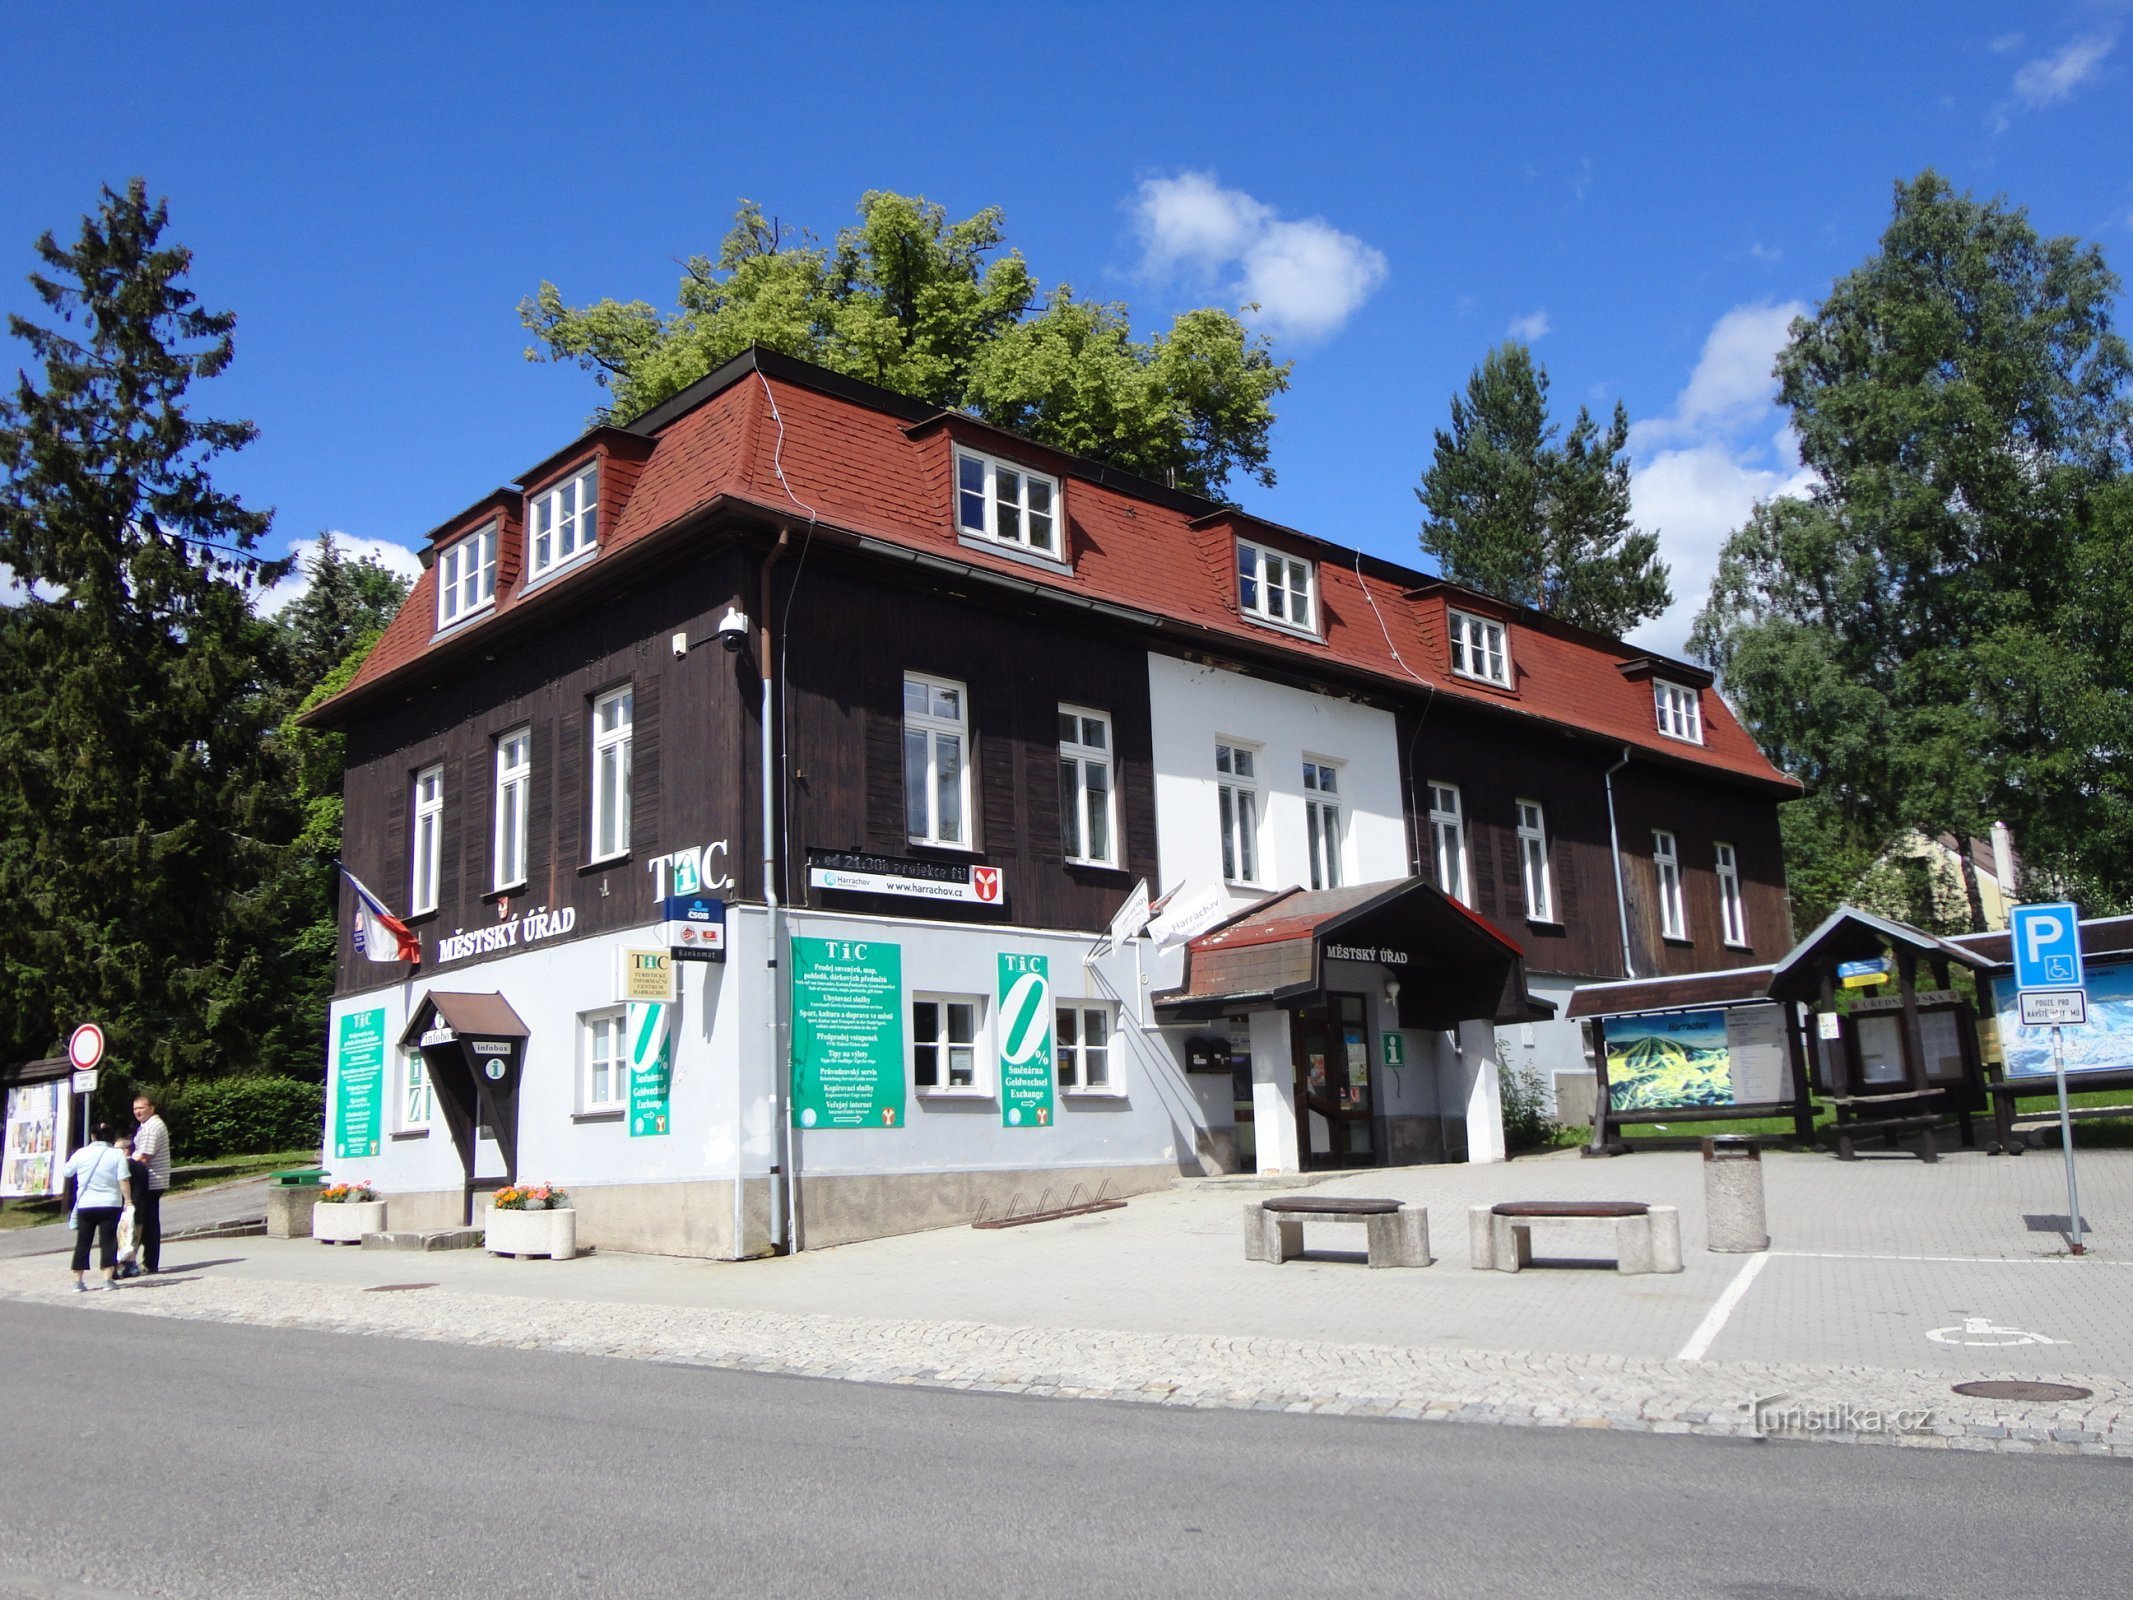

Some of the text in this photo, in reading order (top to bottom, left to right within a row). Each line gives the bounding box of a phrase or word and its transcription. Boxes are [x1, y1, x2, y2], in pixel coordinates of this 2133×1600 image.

[648, 839, 728, 904] TiC
[837, 875, 870, 887] Harrachov
[886, 881, 963, 897] www.harrachov.cz
[687, 910, 710, 920] ČSOB
[1172, 899, 1219, 932] Harrachov
[439, 905, 576, 963] MĚSTSKÝ ÚŘAD
[2025, 915, 2063, 963] P
[678, 949, 716, 959] Bankomat
[825, 941, 868, 961] TiC
[1326, 944, 1408, 964] MĚSTSKÝ ÚŘAD
[631, 953, 669, 971] TiC
[1004, 955, 1041, 972] TiC
[814, 963, 834, 973] Prodej
[829, 973, 860, 983] dárkových
[823, 994, 870, 1004] Ubytovací služby
[2035, 998, 2070, 1007] POUZE PRO
[799, 1009, 818, 1018] Sport,
[818, 1010, 840, 1018] kultura
[845, 1011, 869, 1020] doprava
[816, 1032, 879, 1042] Předprodej vstupenek
[477, 1044, 508, 1052] infobox
[828, 1050, 842, 1059] Tipy
[851, 1050, 868, 1059] výlety
[861, 1068, 878, 1076] servis
[1008, 1065, 1044, 1075] Směnárna
[1005, 1076, 1048, 1087] Geldwechsel
[823, 1084, 874, 1093] Kopírovací služby
[1010, 1088, 1045, 1100] Exchange
[825, 1101, 849, 1109] Veřejný
